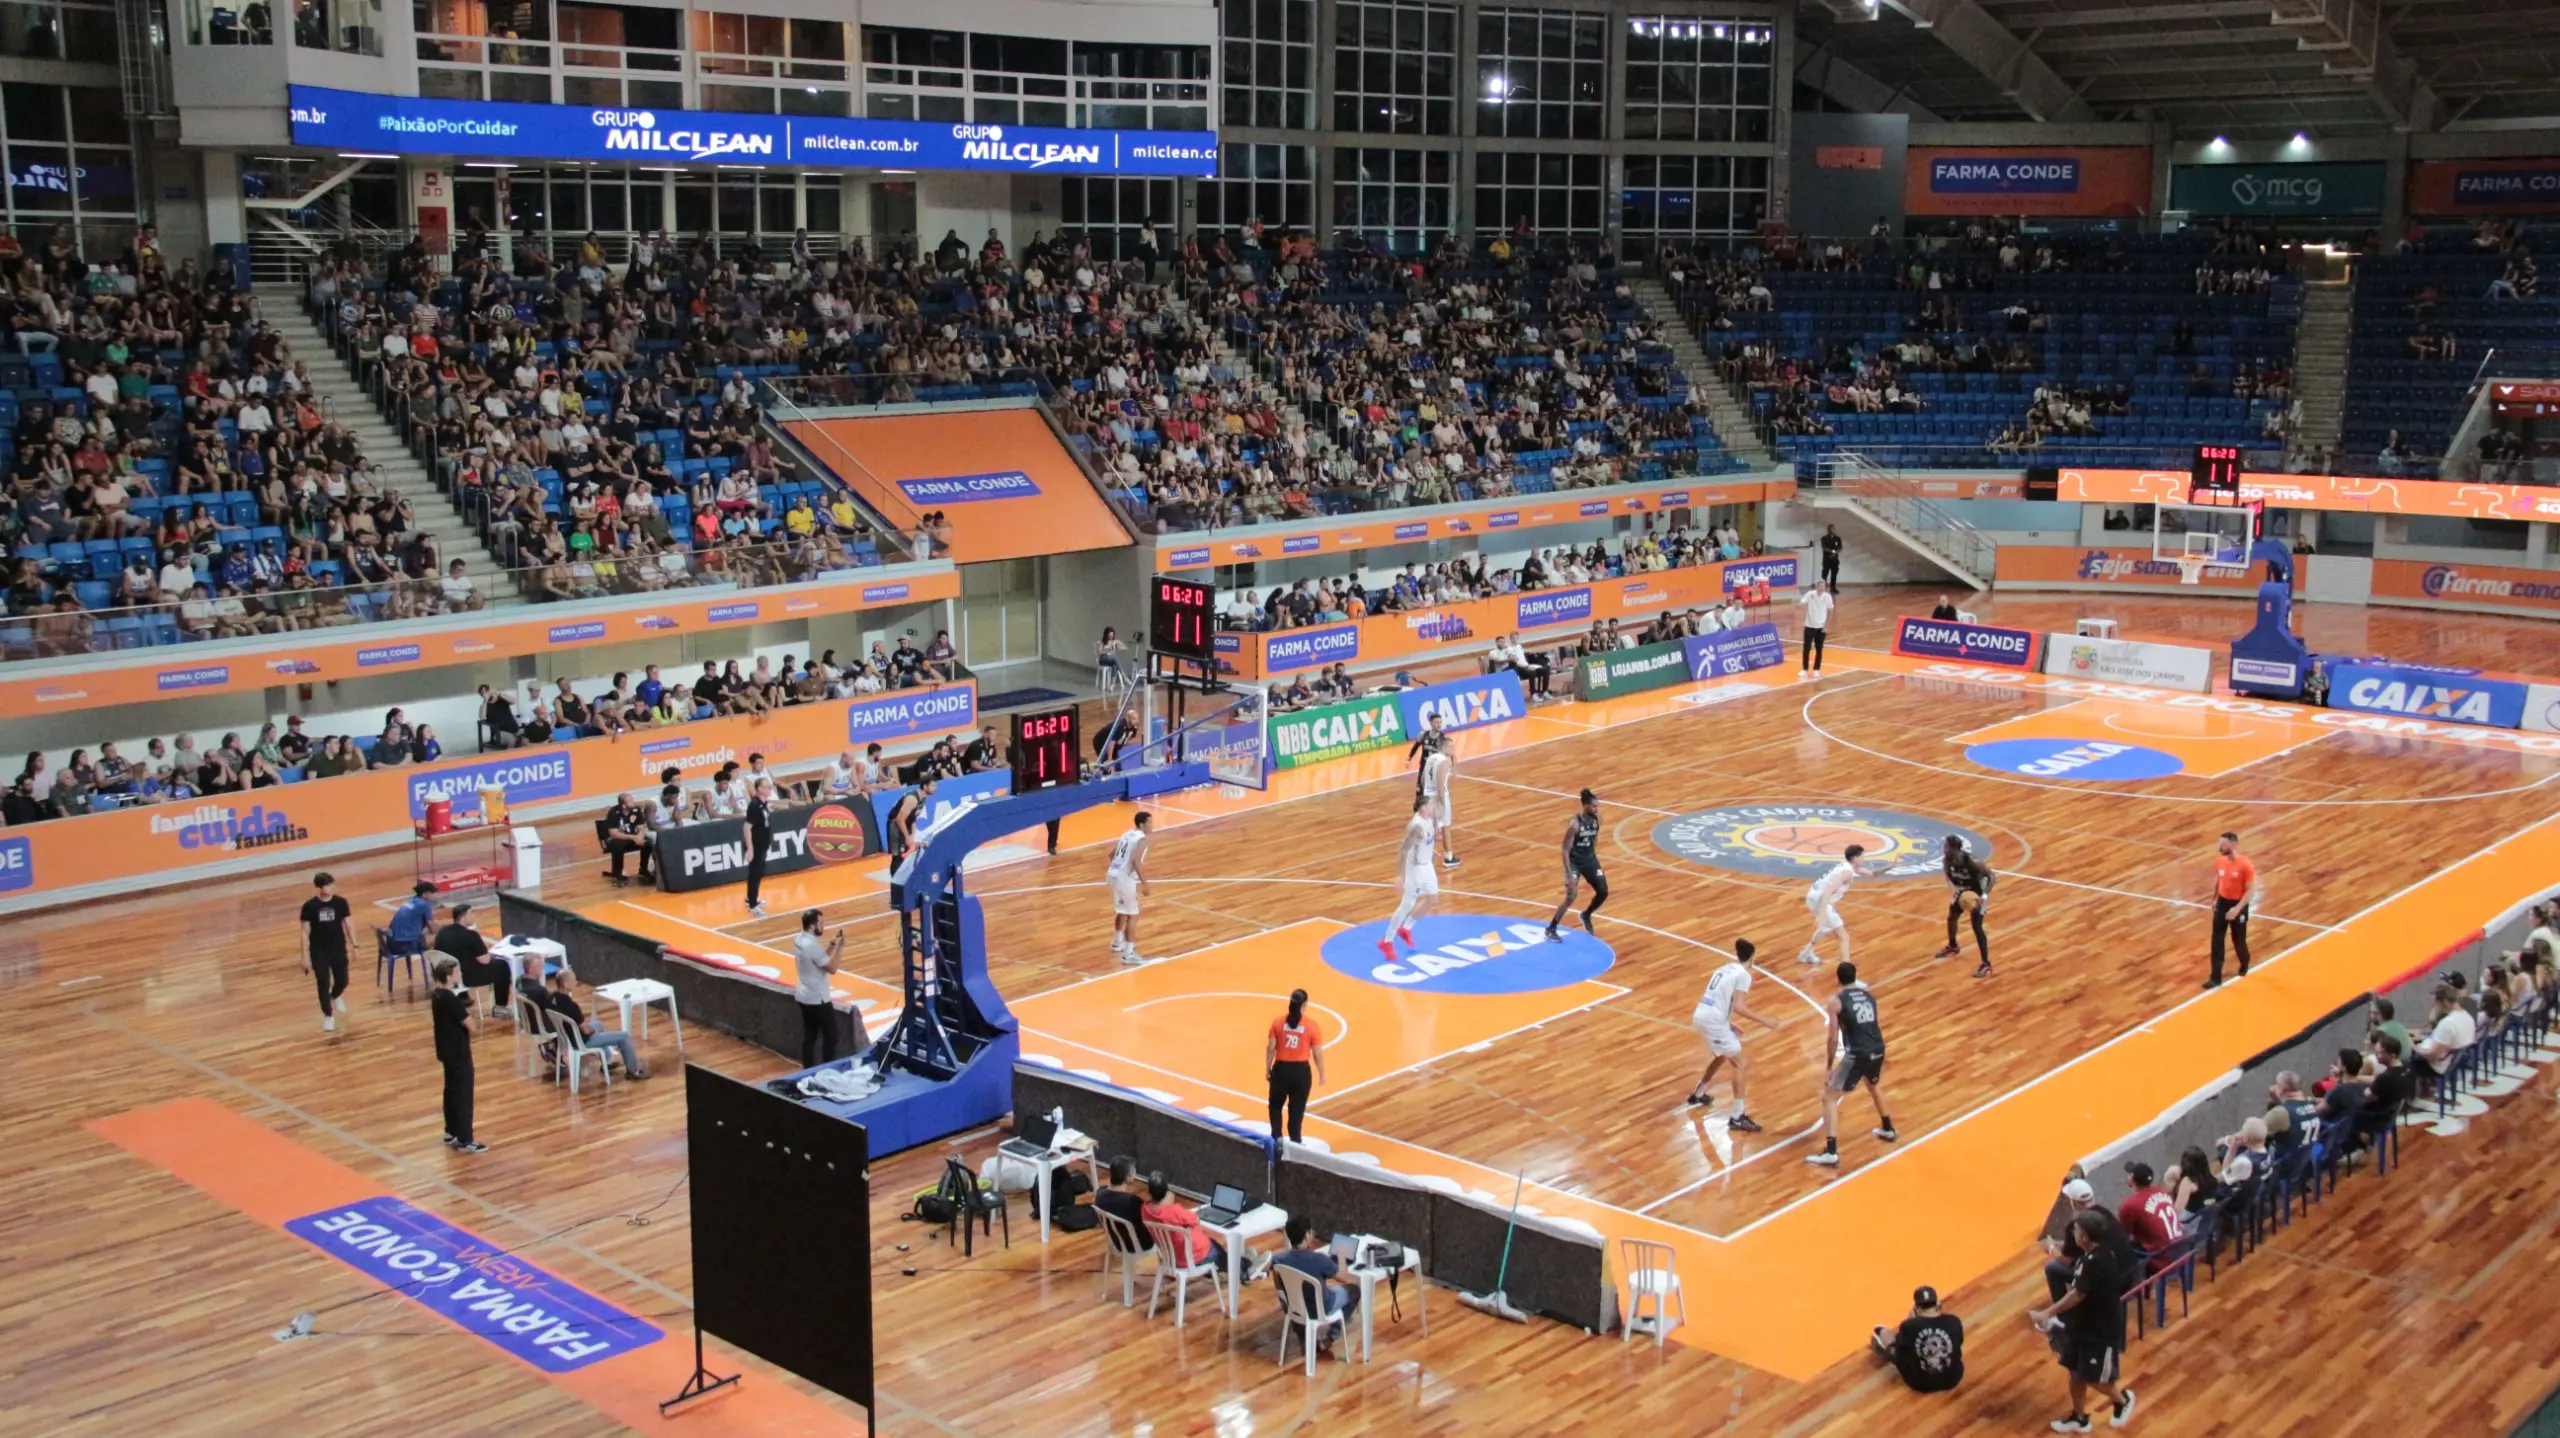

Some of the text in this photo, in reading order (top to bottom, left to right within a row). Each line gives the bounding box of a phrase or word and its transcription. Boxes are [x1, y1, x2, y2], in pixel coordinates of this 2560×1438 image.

[379, 115, 518, 137] #PaixãoPorCuidar
[592, 110, 655, 129] GRUPO
[953, 124, 1002, 141] GRUPO
[605, 129, 773, 160] MILCLEAN
[804, 134, 920, 153] milclean.com.br
[963, 140, 1100, 168] MILCLEAN
[1936, 164, 2073, 180] FARMA CONDE
[2459, 177, 2523, 192] FARMA
[2266, 176, 2323, 205] mcg
[2201, 447, 2237, 459] 06:20
[904, 475, 1031, 496] FARMA CONDE
[2210, 462, 2233, 483] 11
[1757, 563, 1794, 578] CONDE
[1161, 584, 1204, 606] 06:20
[1519, 591, 1590, 617] FARMA CONDE
[550, 623, 605, 638] FARMA CONDE
[1174, 612, 1201, 646] 11
[1418, 613, 1466, 639] cuida
[1904, 624, 2026, 653] FARMA CONDE
[358, 646, 420, 662] FARMA CONDE
[1214, 637, 1239, 648] ONDE
[1269, 631, 1356, 660] FARMA CONDE
[159, 668, 228, 685] FARMA CONDE
[1611, 651, 1683, 677] LOJANBB.COM.BR
[1914, 662, 2027, 684] SÃO
[2169, 696, 2304, 718] DOS
[2348, 677, 2492, 723] CAIXA
[852, 693, 969, 729] FARMA CONDE
[1418, 687, 1513, 731] CAIXA
[1023, 715, 1069, 739] 06:20
[1276, 703, 1400, 756] NBB CAIXA
[1232, 737, 1260, 751] ATLETA
[1292, 746, 1351, 767] TEMPORADA
[1039, 742, 1066, 778] 11
[2017, 741, 2134, 775] CAIXA
[494, 759, 566, 787] CONDE
[813, 816, 856, 831] PENALTY
[1739, 807, 1857, 819] CAMPOS
[178, 805, 289, 850] cuida
[235, 824, 309, 850] família
[1371, 923, 1572, 984] CAIXA
[2300, 1116, 2321, 1146] 77
[2158, 1206, 2183, 1240] 12
[312, 1210, 611, 1362] FARMA CONDE
